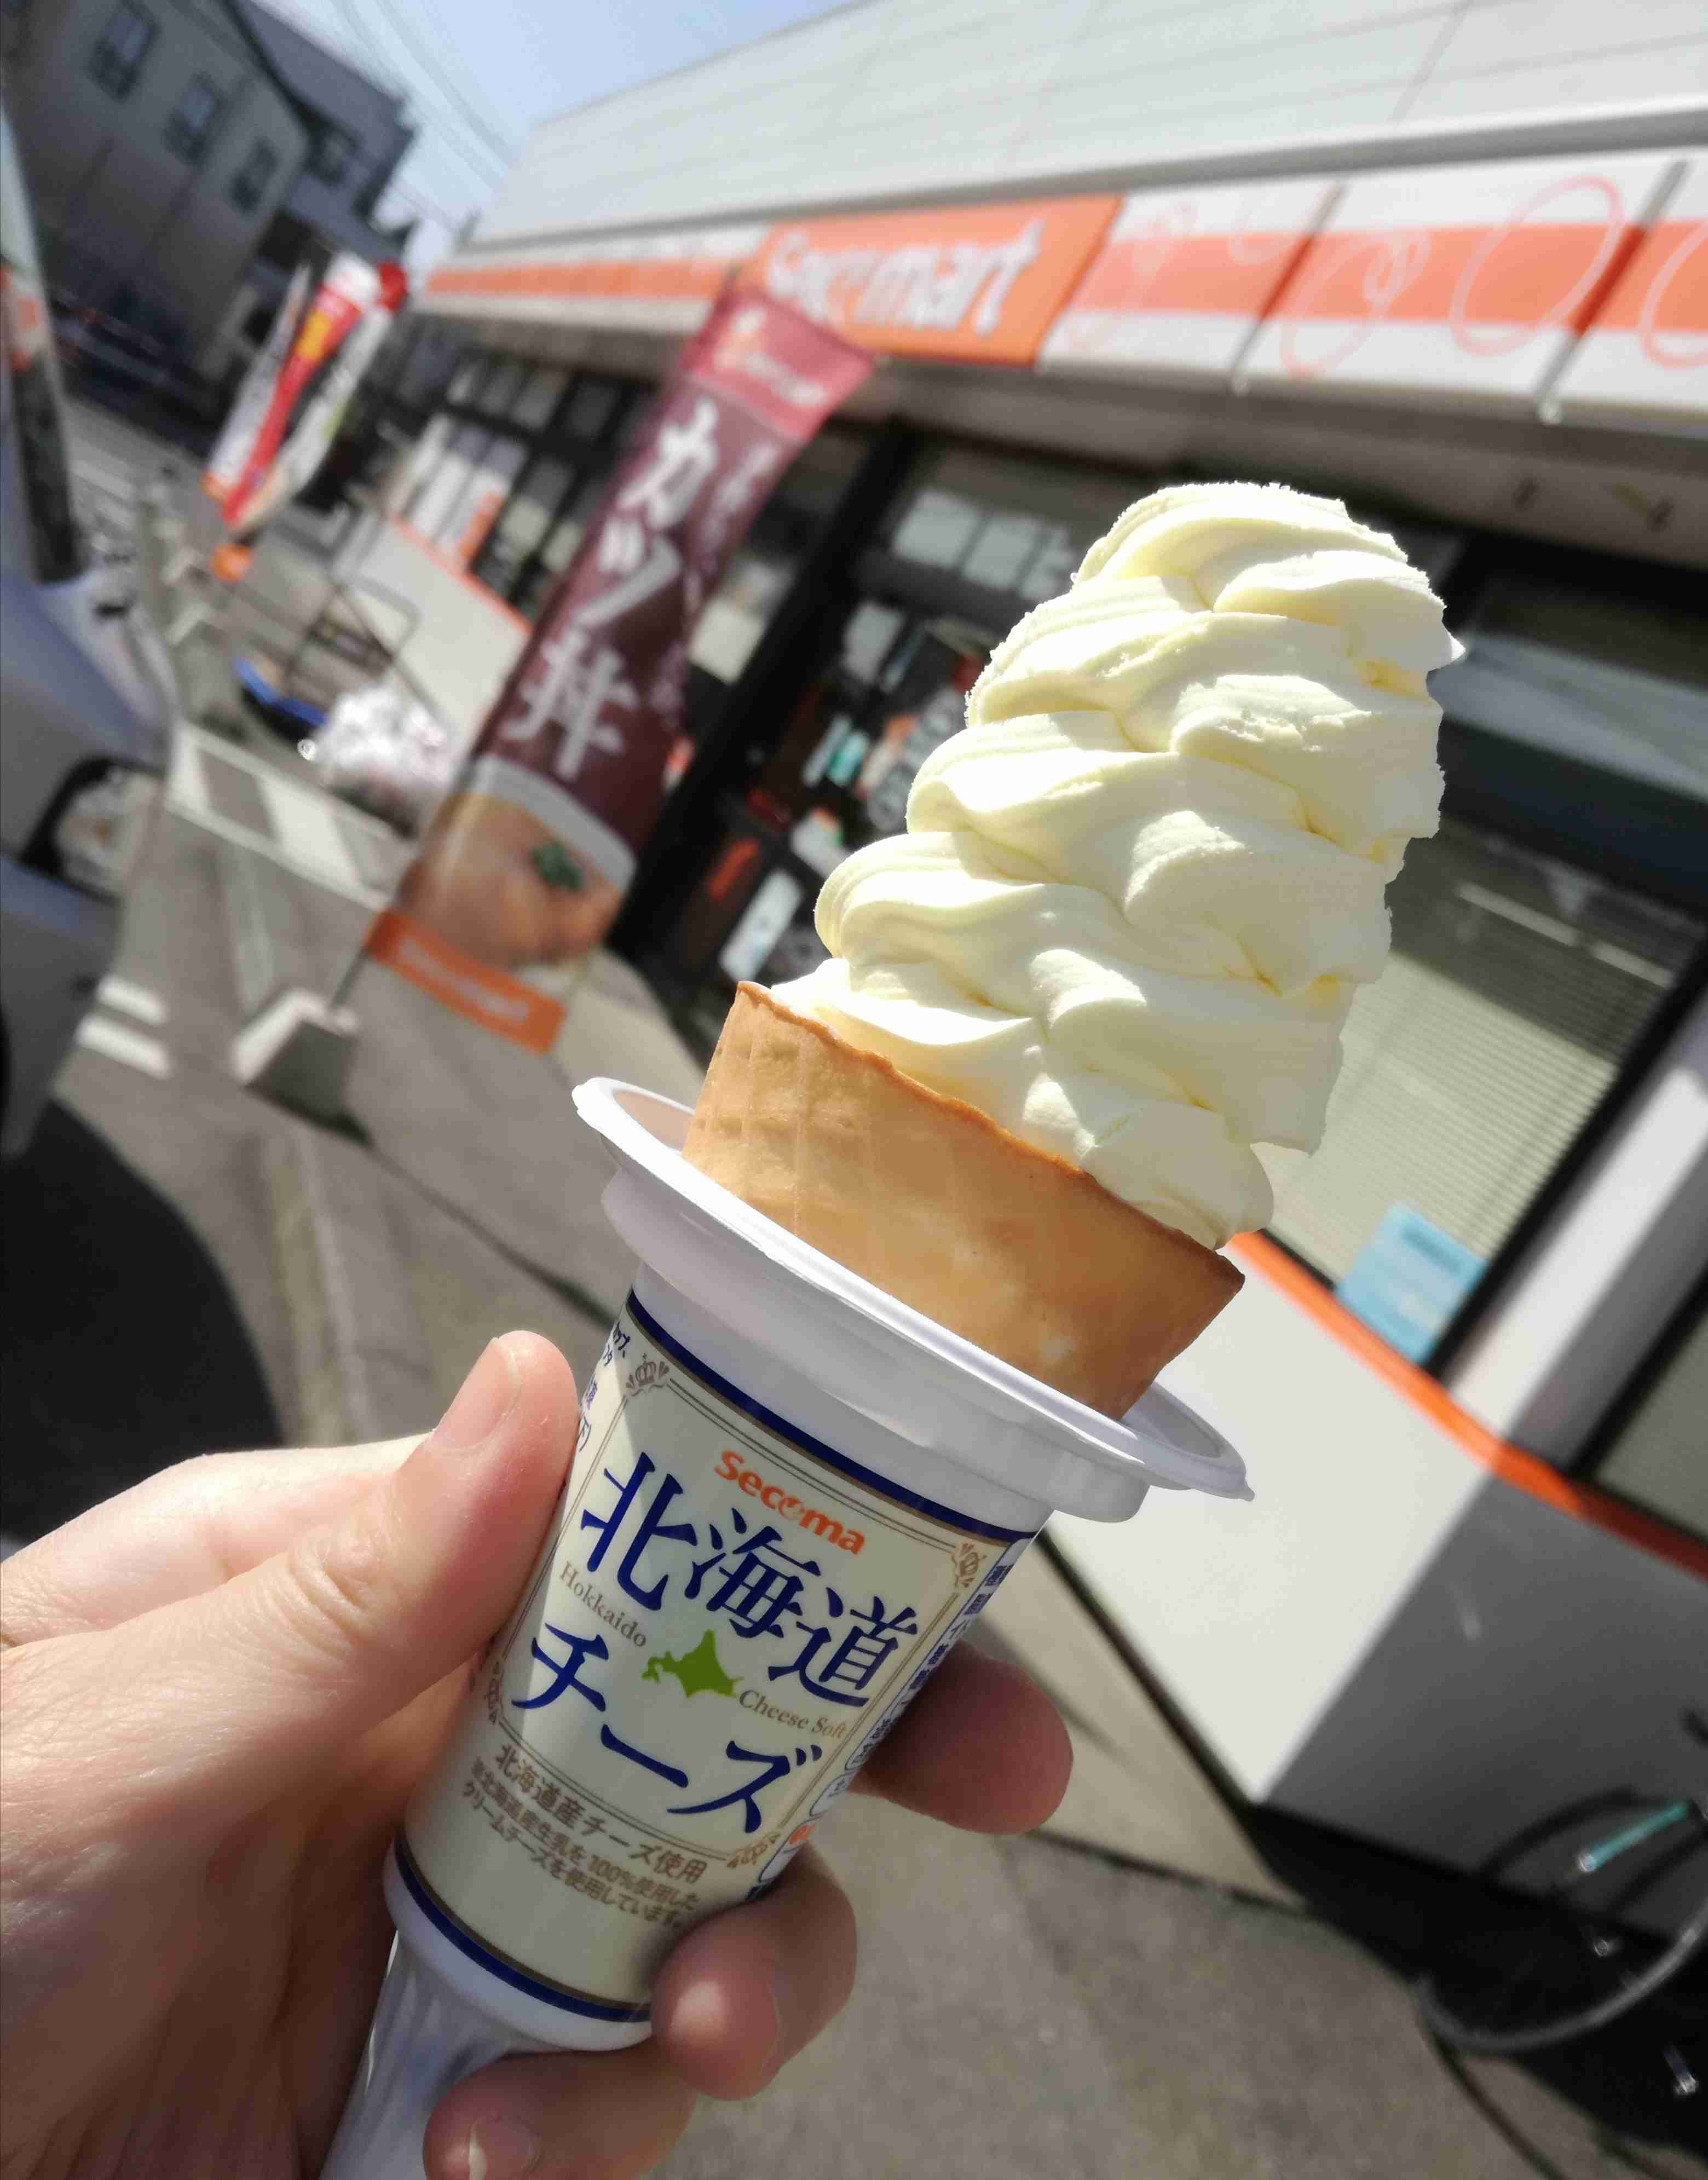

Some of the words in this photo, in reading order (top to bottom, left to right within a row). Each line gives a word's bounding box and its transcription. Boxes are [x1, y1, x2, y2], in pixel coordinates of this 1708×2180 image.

[713, 1449, 865, 1555] Secoma
[560, 1560, 647, 1647] Hokkaido
[580, 1451, 919, 1708] 北海道
[511, 1622, 823, 1834] チーズ
[739, 1689, 809, 1729] Cheese
[811, 1715, 847, 1738] Soft
[496, 1744, 707, 1884] 北海道産チーズ使用
